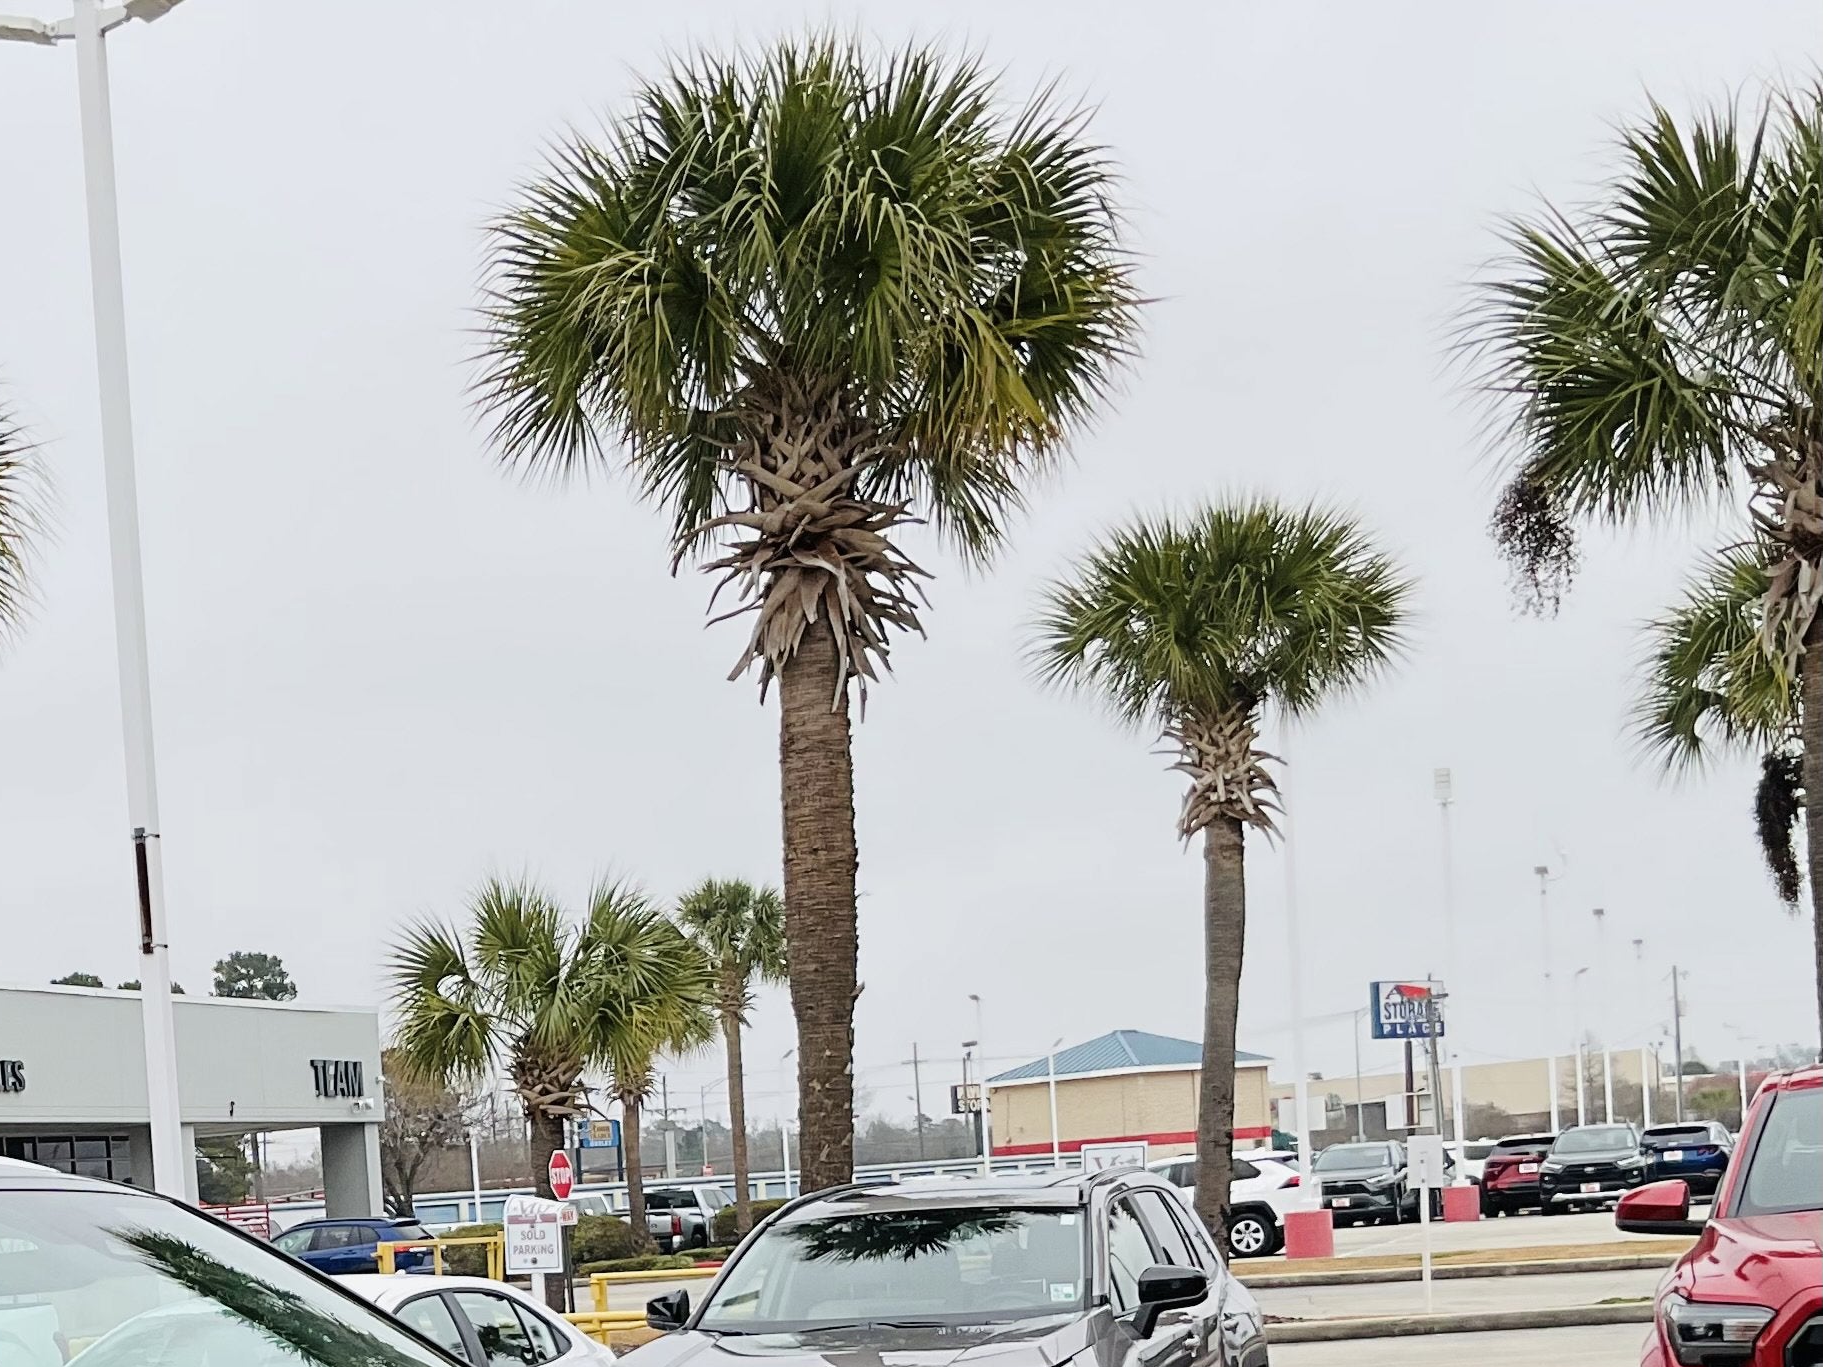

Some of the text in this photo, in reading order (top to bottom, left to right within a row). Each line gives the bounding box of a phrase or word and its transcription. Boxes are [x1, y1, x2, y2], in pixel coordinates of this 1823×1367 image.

[1384, 1001, 1442, 1021] STORAE
[310, 1059, 364, 1098] TEAM
[551, 1167, 571, 1184] STOP
[520, 1230, 546, 1241] SOLD
[513, 1244, 554, 1256] PARKING
